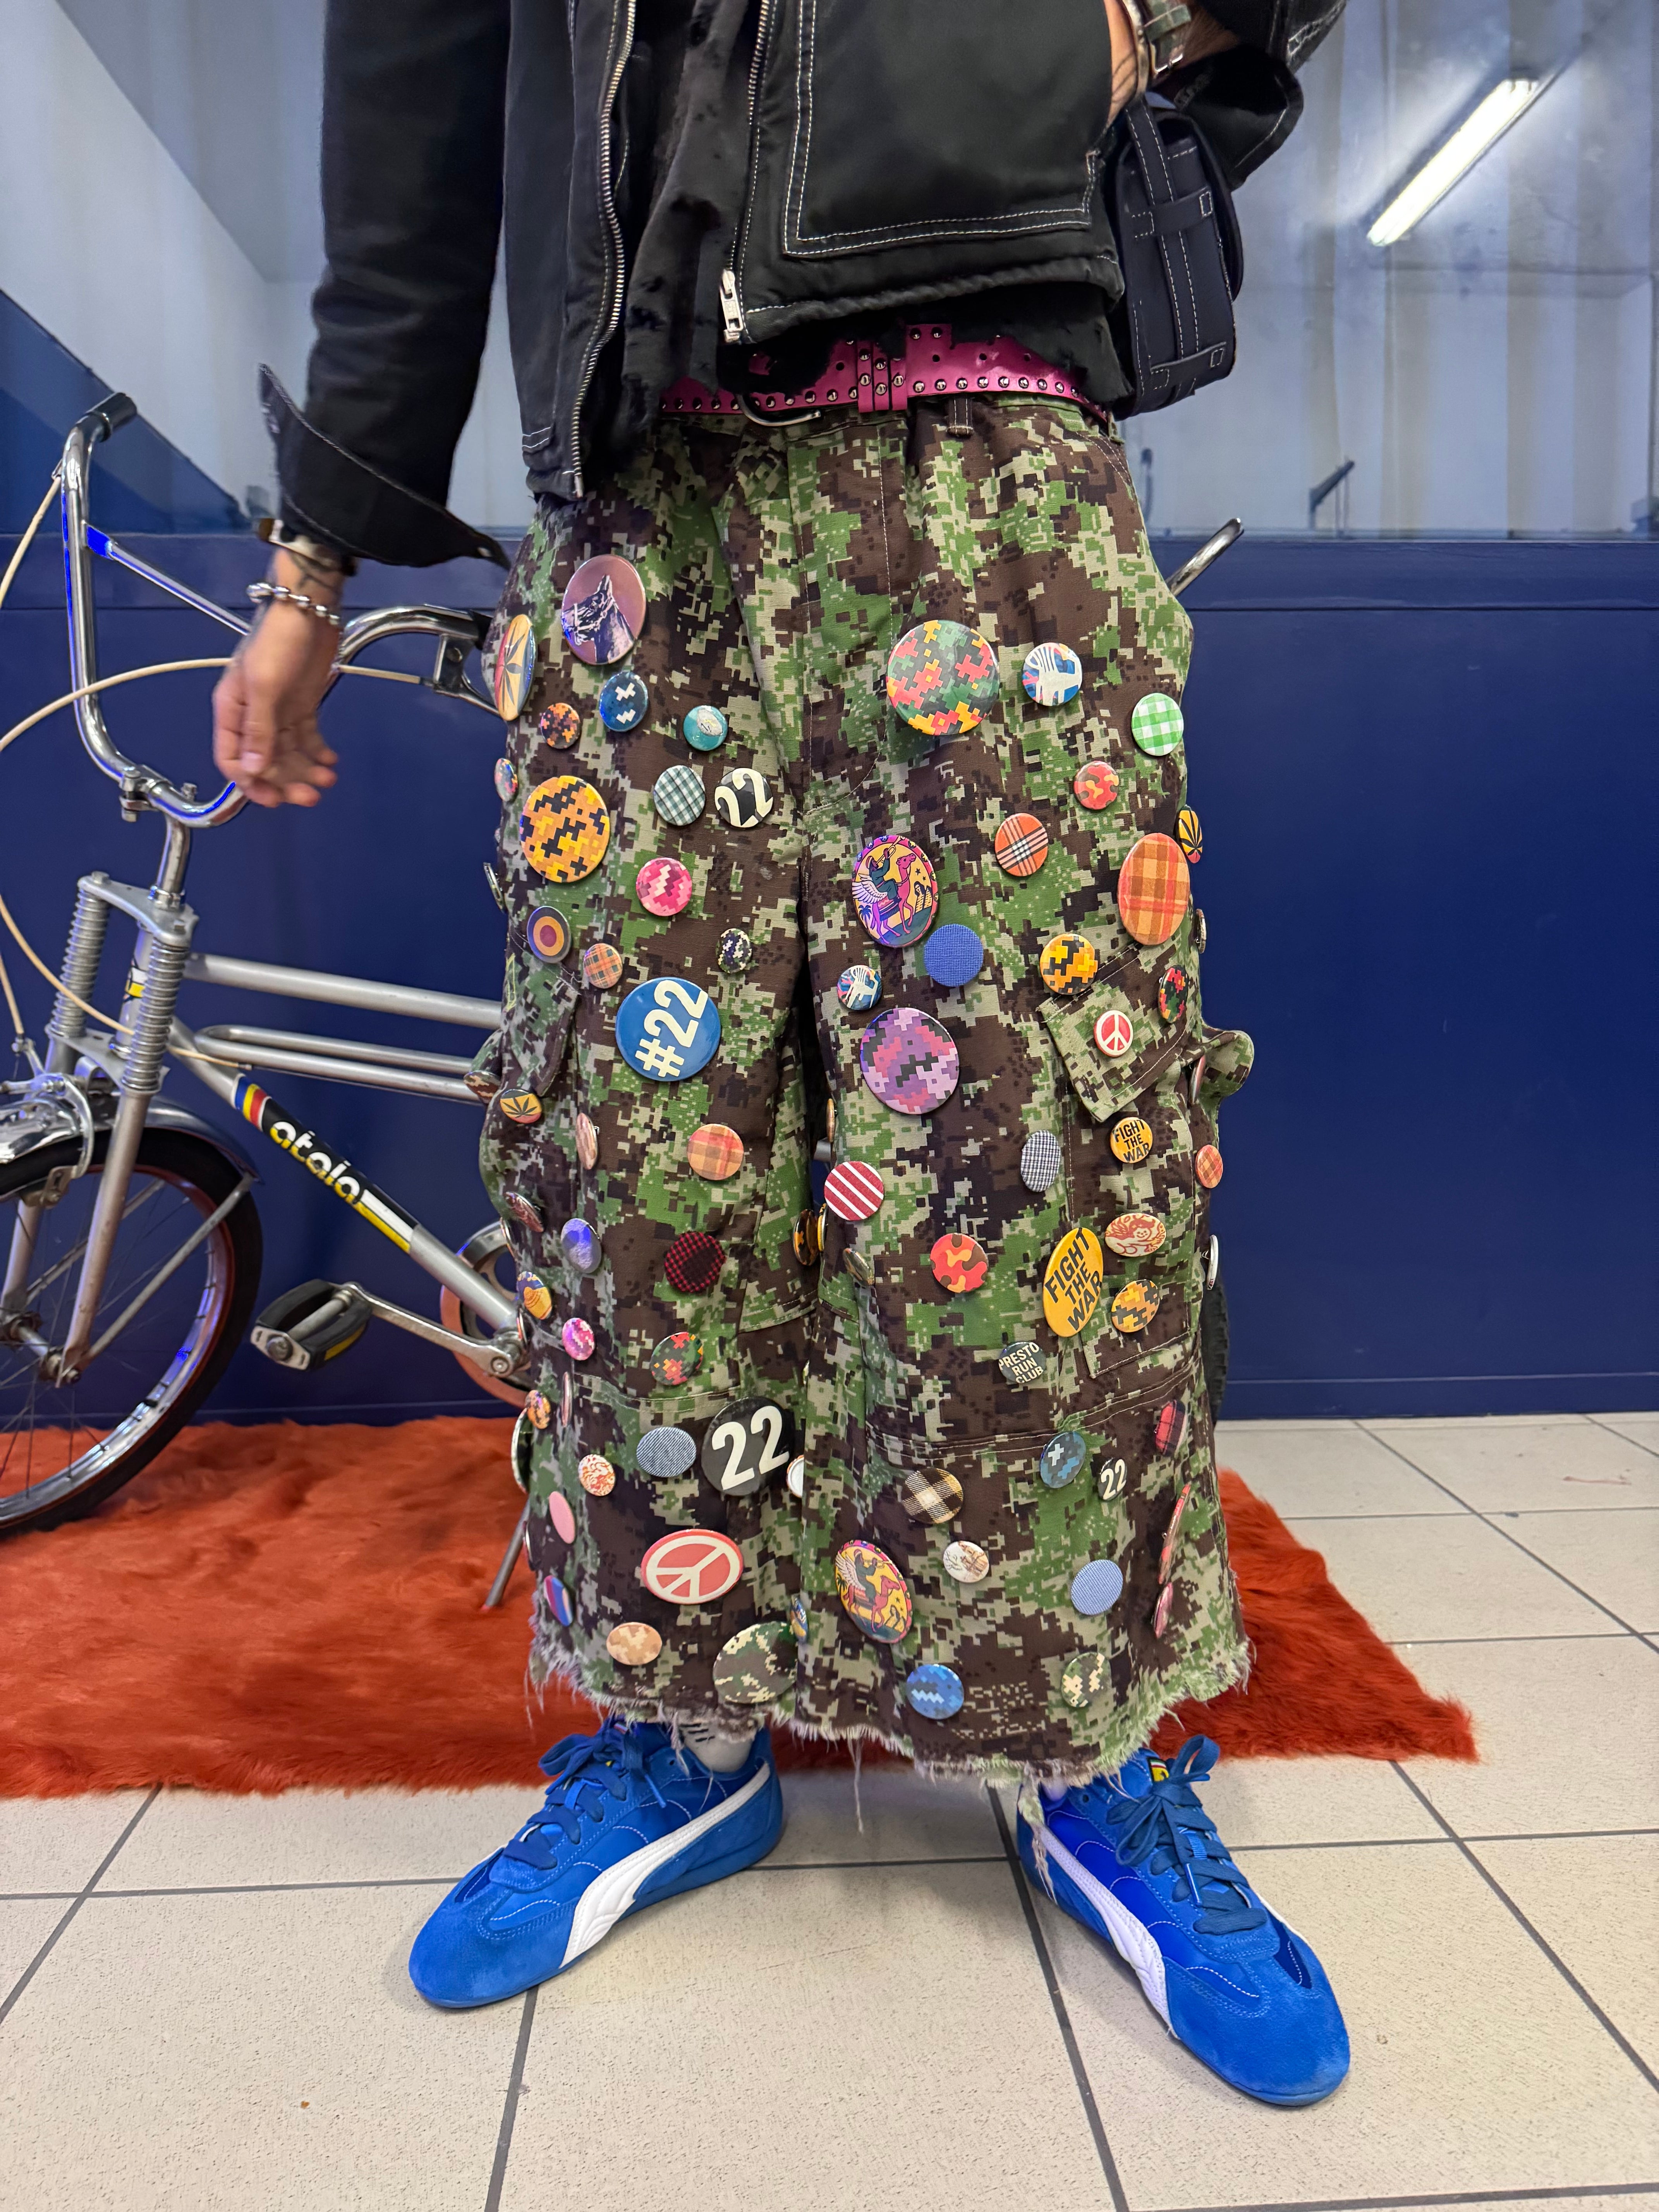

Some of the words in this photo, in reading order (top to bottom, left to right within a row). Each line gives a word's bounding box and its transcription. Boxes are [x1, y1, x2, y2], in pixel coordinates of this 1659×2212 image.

[714, 768, 773, 828] 22
[635, 980, 708, 1077] #22
[1112, 1120, 1145, 1142] FIGHT
[1123, 1142, 1150, 1162] WAR
[1124, 1133, 1143, 1150] THE
[270, 1121, 360, 1204] atala
[1045, 1227, 1089, 1304] FIGHT
[1065, 1261, 1091, 1305] THE
[1067, 1271, 1103, 1331] WAR
[998, 1342, 1039, 1370] PRESTO
[1012, 1357, 1037, 1376] RUN
[1016, 1366, 1044, 1383] CLUB
[712, 1405, 790, 1490] 22
[1101, 1459, 1127, 1500] 22
